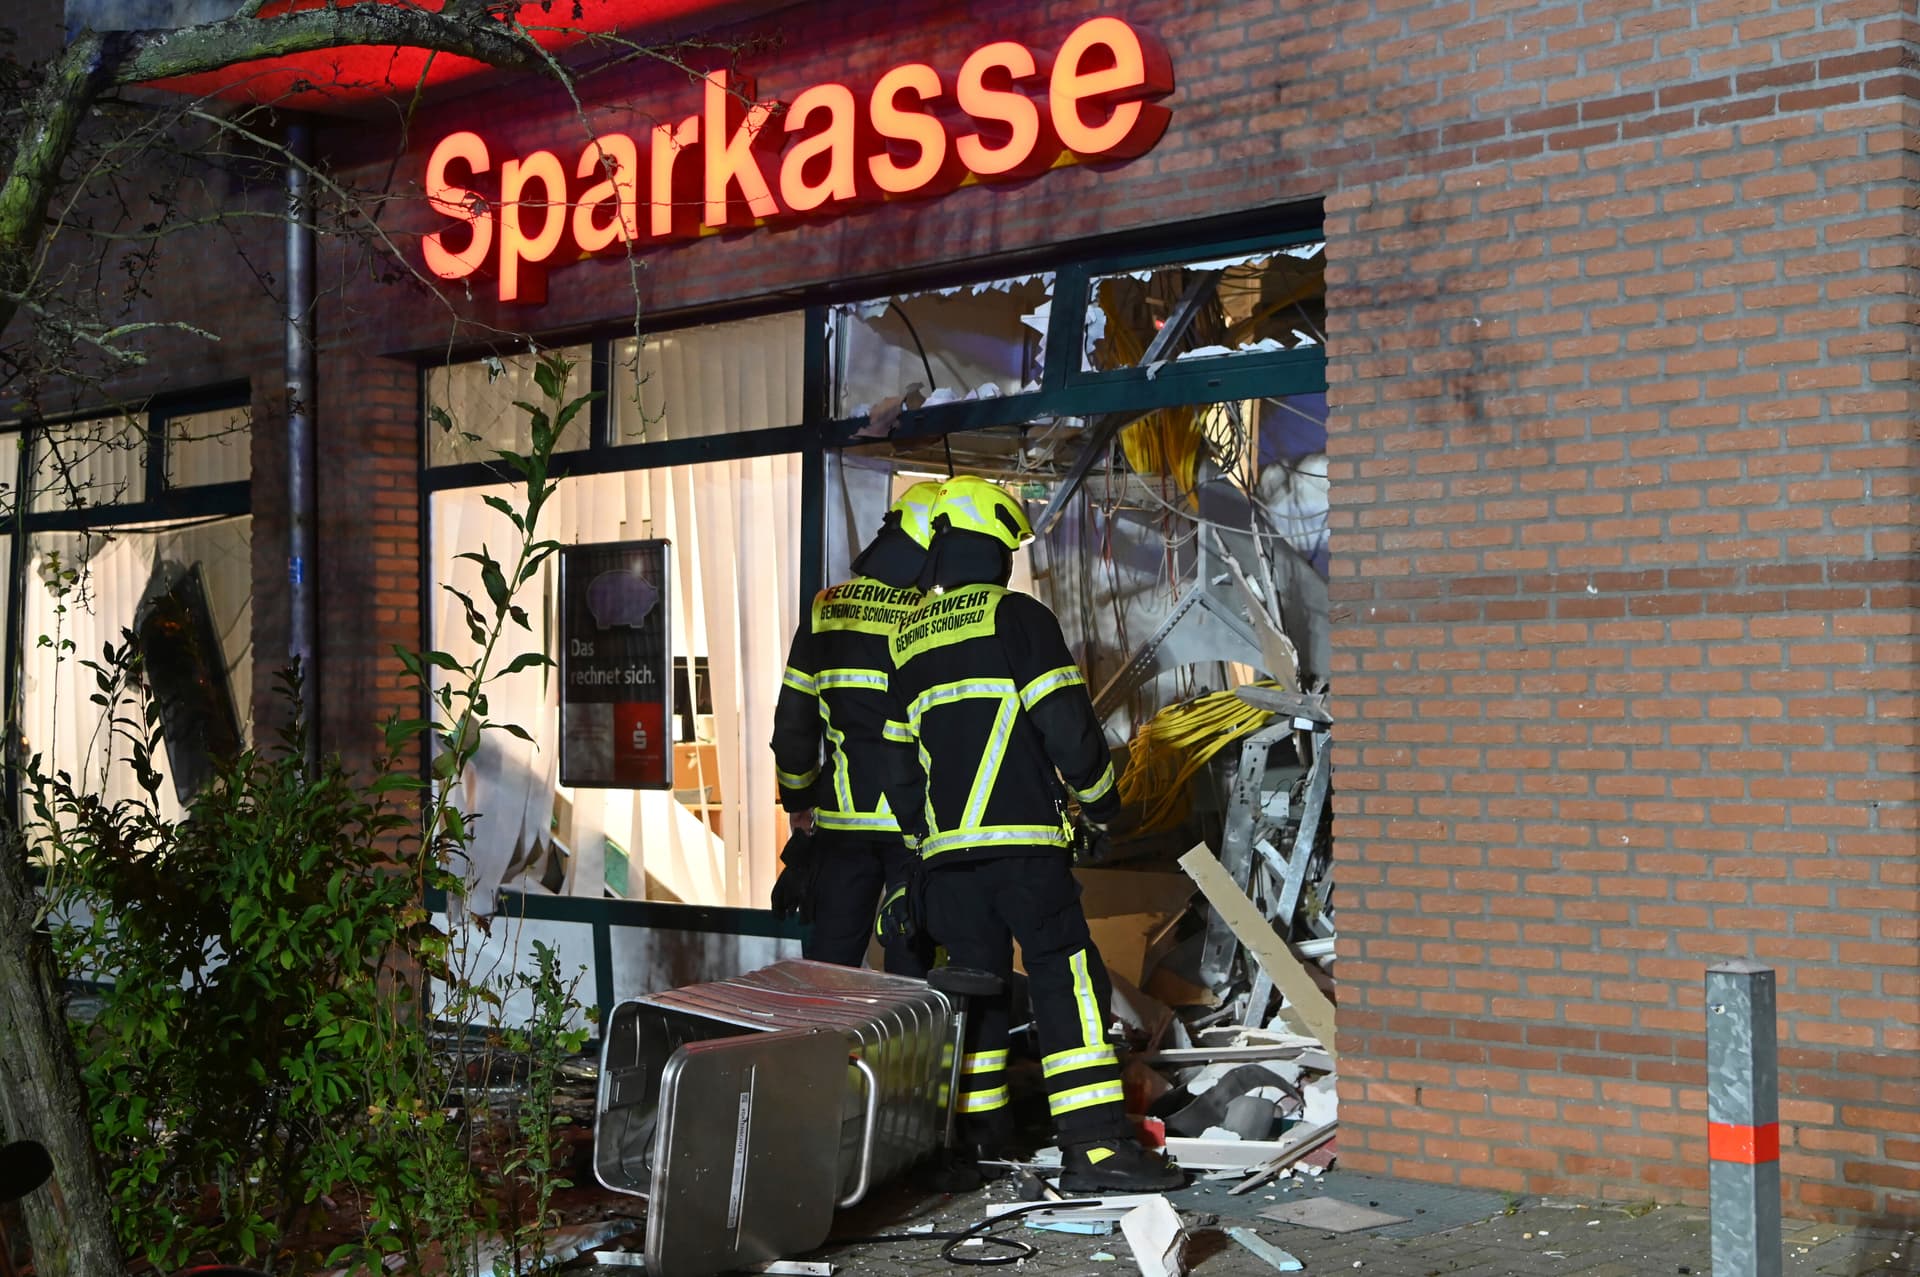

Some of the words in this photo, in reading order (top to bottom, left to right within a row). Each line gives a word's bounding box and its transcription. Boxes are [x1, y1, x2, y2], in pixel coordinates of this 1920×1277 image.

[422, 16, 1147, 303] Sparkasse
[825, 584, 922, 607] FEUERWEHR
[821, 605, 862, 621] GEMEINDE
[899, 590, 990, 633] FEUERWEHR
[896, 625, 930, 653] GEMEINDE
[931, 609, 985, 635] SCHÖNEFELD
[571, 638, 594, 656] Das
[571, 665, 620, 685] rechnet
[624, 664, 656, 684] sich.
